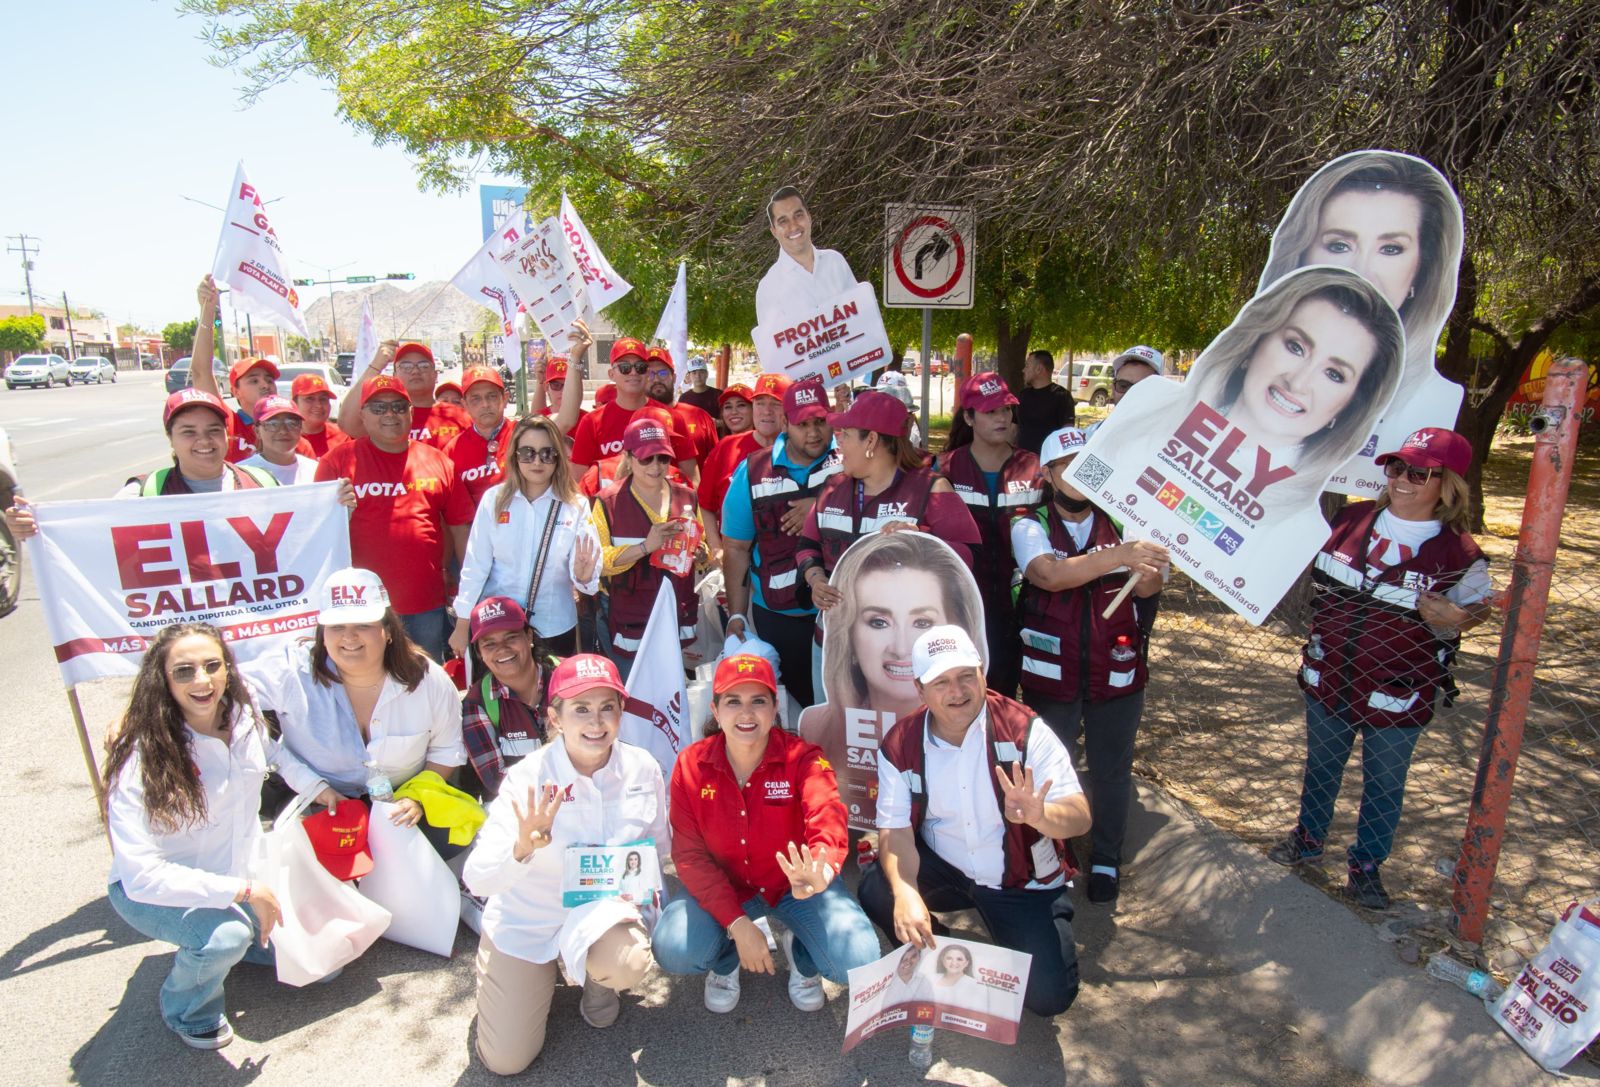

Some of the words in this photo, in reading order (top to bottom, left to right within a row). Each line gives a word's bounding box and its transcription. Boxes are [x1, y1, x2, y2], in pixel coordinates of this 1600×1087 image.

[242, 264, 261, 281] VOTA
[260, 273, 280, 291] PLAN
[773, 301, 859, 349] FROYLÁN
[794, 322, 850, 357] GÁMEZ
[808, 341, 842, 360] SENADOR
[848, 355, 870, 369] SOMOS
[830, 365, 843, 379] PT
[795, 388, 817, 401] ELY
[979, 379, 999, 392] ELY
[1058, 432, 1087, 445] ELY
[600, 440, 624, 456] VO
[1174, 400, 1297, 499] ELY
[461, 461, 501, 481] VOTA
[1162, 438, 1266, 522] SALLARD
[355, 482, 408, 499] VOTA
[415, 477, 438, 491] PT
[1008, 480, 1032, 492] ELY
[1156, 452, 1188, 479] CANDIDATA
[1191, 479, 1219, 502] DIPUTADA
[1217, 497, 1236, 516] LOCAL
[1157, 488, 1180, 507] PT
[877, 502, 908, 514] ELY
[1101, 489, 1116, 507] Ely
[1115, 500, 1149, 529] Sallard
[1150, 528, 1202, 570] @elysallard
[1220, 532, 1239, 550] PES
[111, 511, 294, 590] ELY
[1404, 570, 1438, 589] ELY
[127, 574, 305, 618] SALLARD
[331, 585, 367, 600] ELY
[1204, 569, 1261, 616] @elysallard8
[129, 615, 187, 629] CANDIDATA
[188, 615, 196, 623] A
[197, 608, 244, 621] DIPUTADA
[245, 603, 274, 614] LOCAL
[275, 599, 302, 609] DTTO.
[478, 602, 502, 615] ELY
[238, 621, 271, 638] MÁS
[273, 615, 320, 633] MORE
[103, 638, 142, 655] MÁS
[928, 639, 956, 650] JACOBO
[928, 644, 958, 655] MENDOZA
[576, 658, 606, 672] ELY
[738, 663, 756, 673] PT
[701, 788, 717, 800] PT
[764, 781, 791, 789] CELIDA
[340, 838, 356, 848] PT
[580, 854, 614, 869] ELY
[978, 967, 1021, 985] CELIDA
[1553, 961, 1576, 983] VOTA
[1543, 978, 1588, 1013] DOLORES
[917, 1010, 931, 1019] PT
[1511, 999, 1544, 1031] morena
[1539, 992, 1578, 1024] RÍO
[944, 1015, 968, 1025] SOMOS
